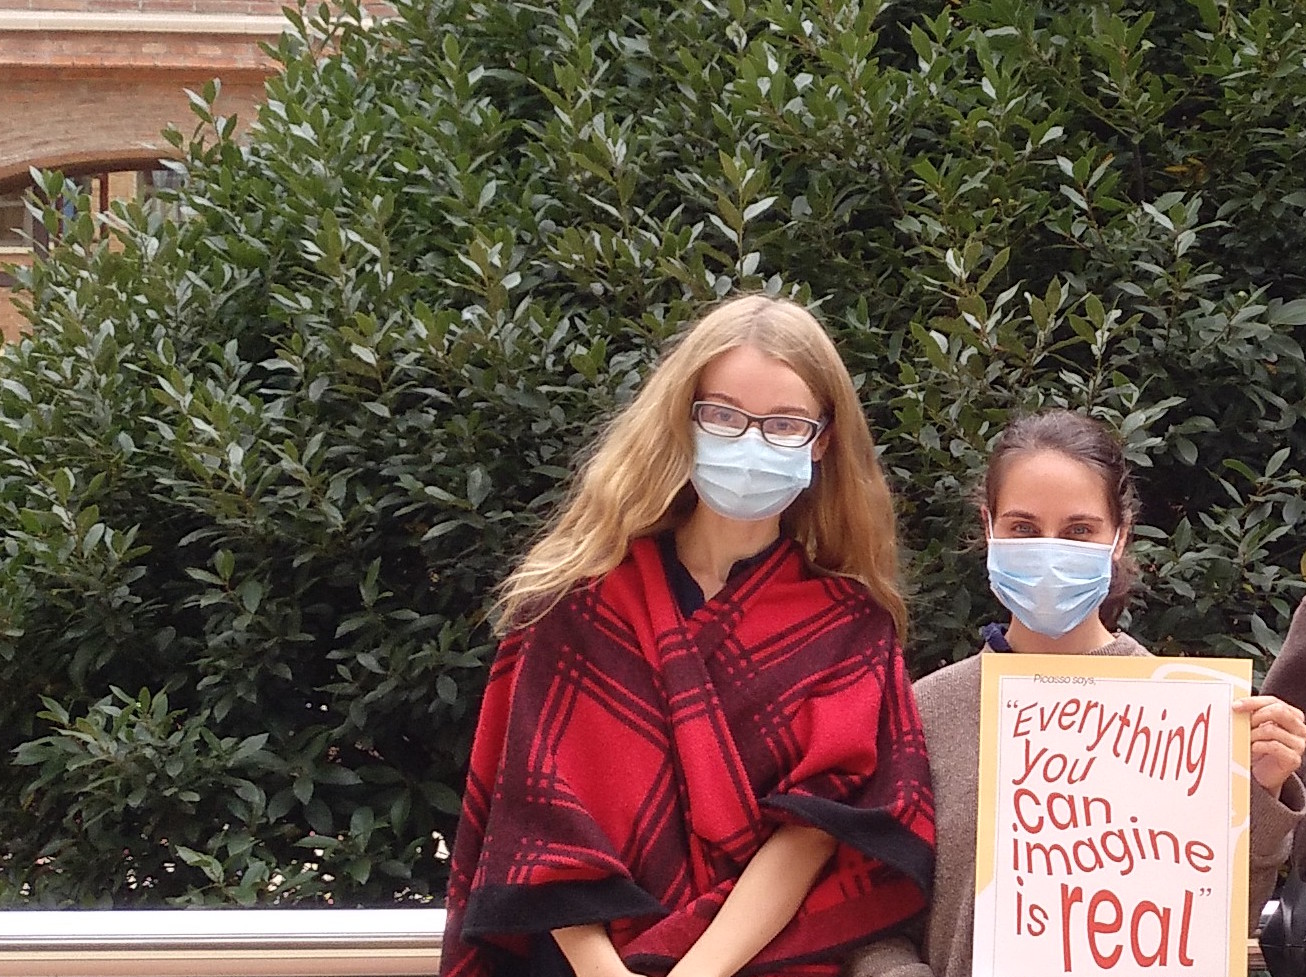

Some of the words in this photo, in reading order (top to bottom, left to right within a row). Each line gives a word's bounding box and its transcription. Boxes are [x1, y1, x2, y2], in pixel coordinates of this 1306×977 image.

[1033, 673, 1070, 684] Picasso
[1072, 676, 1096, 687] says,
[1012, 738, 1097, 785] you
[1013, 788, 1112, 834] can
[1012, 815, 1215, 877] imagine
[1016, 875, 1050, 937] is
